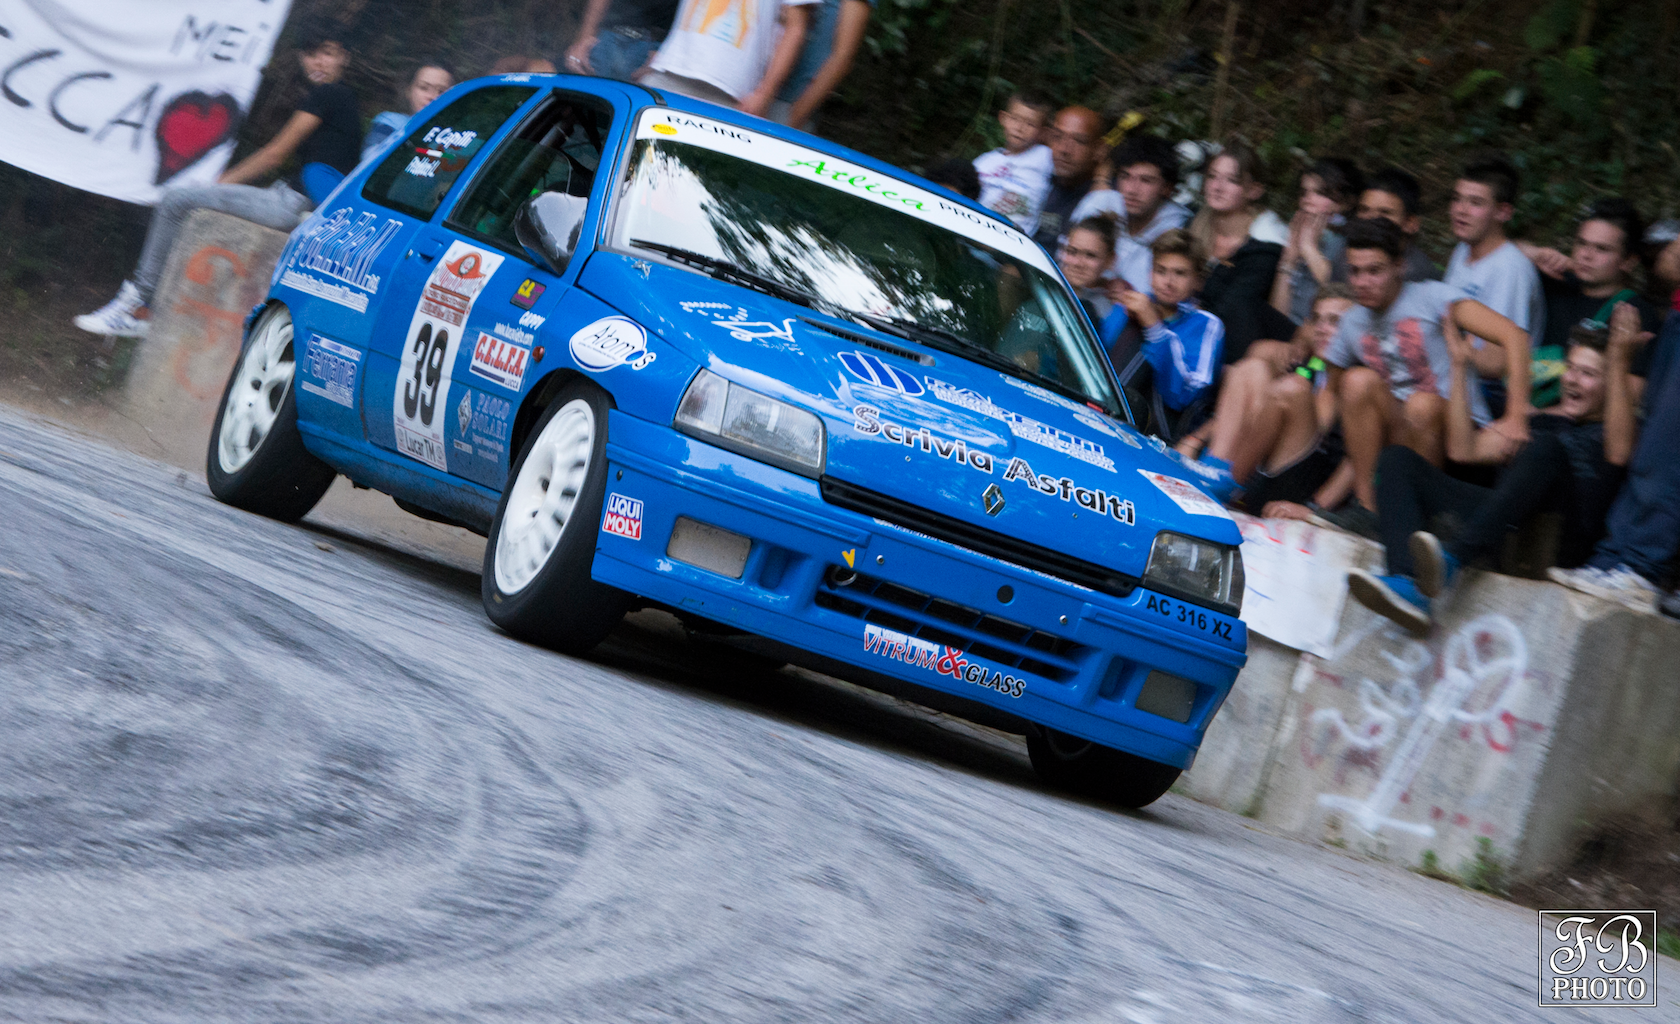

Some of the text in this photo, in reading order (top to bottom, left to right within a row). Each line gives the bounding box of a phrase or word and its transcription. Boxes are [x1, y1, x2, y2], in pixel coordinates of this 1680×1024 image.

[667, 115, 752, 143] RACING
[939, 201, 1025, 245] PROJECT
[475, 335, 524, 378] C.E.L.F.A.
[404, 320, 449, 428] 39
[505, 377, 519, 389] LUCCA
[476, 392, 510, 421] PAOLO
[471, 411, 508, 441] SOLARI
[853, 405, 993, 474] Scrivia
[1002, 457, 1135, 526] Asfalti
[609, 495, 641, 519] LIQUI
[604, 513, 640, 537] MOLY
[1146, 594, 1232, 641] AC 316 XZ
